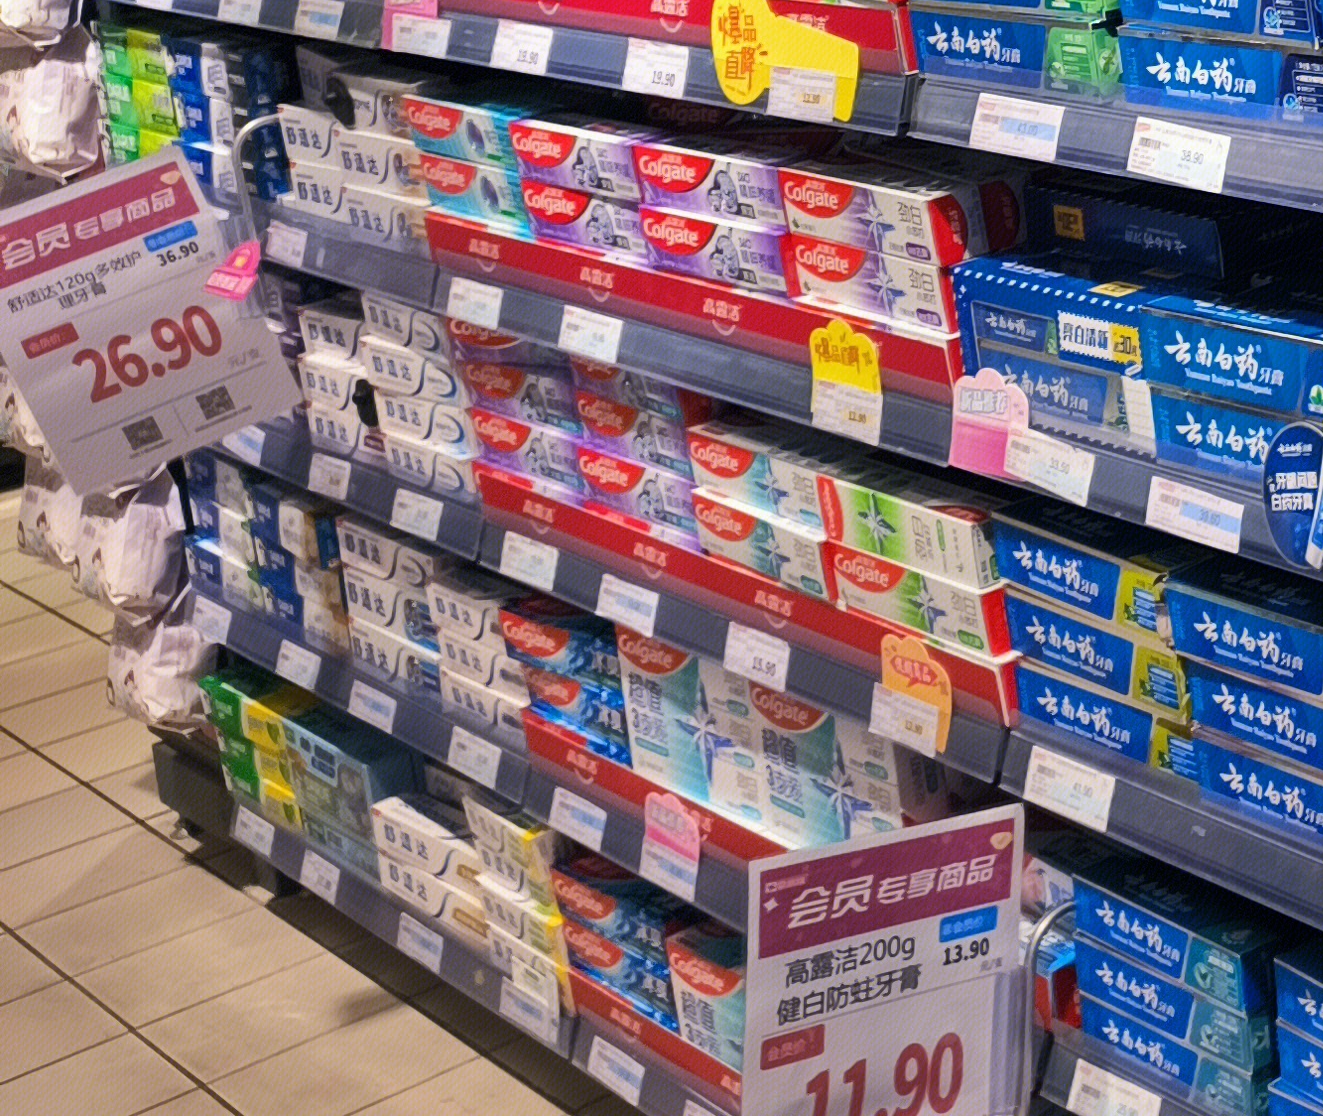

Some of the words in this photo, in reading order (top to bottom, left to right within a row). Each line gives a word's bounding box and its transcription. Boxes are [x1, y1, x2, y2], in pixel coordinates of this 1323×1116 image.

[639, 156, 696, 183] Colgate
[643, 218, 698, 245] Colgate
[156, 242, 199, 266] 36.90
[796, 248, 849, 273] Colgate
[72, 305, 222, 403] 26.90
[787, 854, 998, 930] 会员专享商品
[785, 935, 916, 988] 高露洁200g
[943, 938, 990, 965] 13.90
[777, 963, 922, 1026] 健白防蛀牙膏
